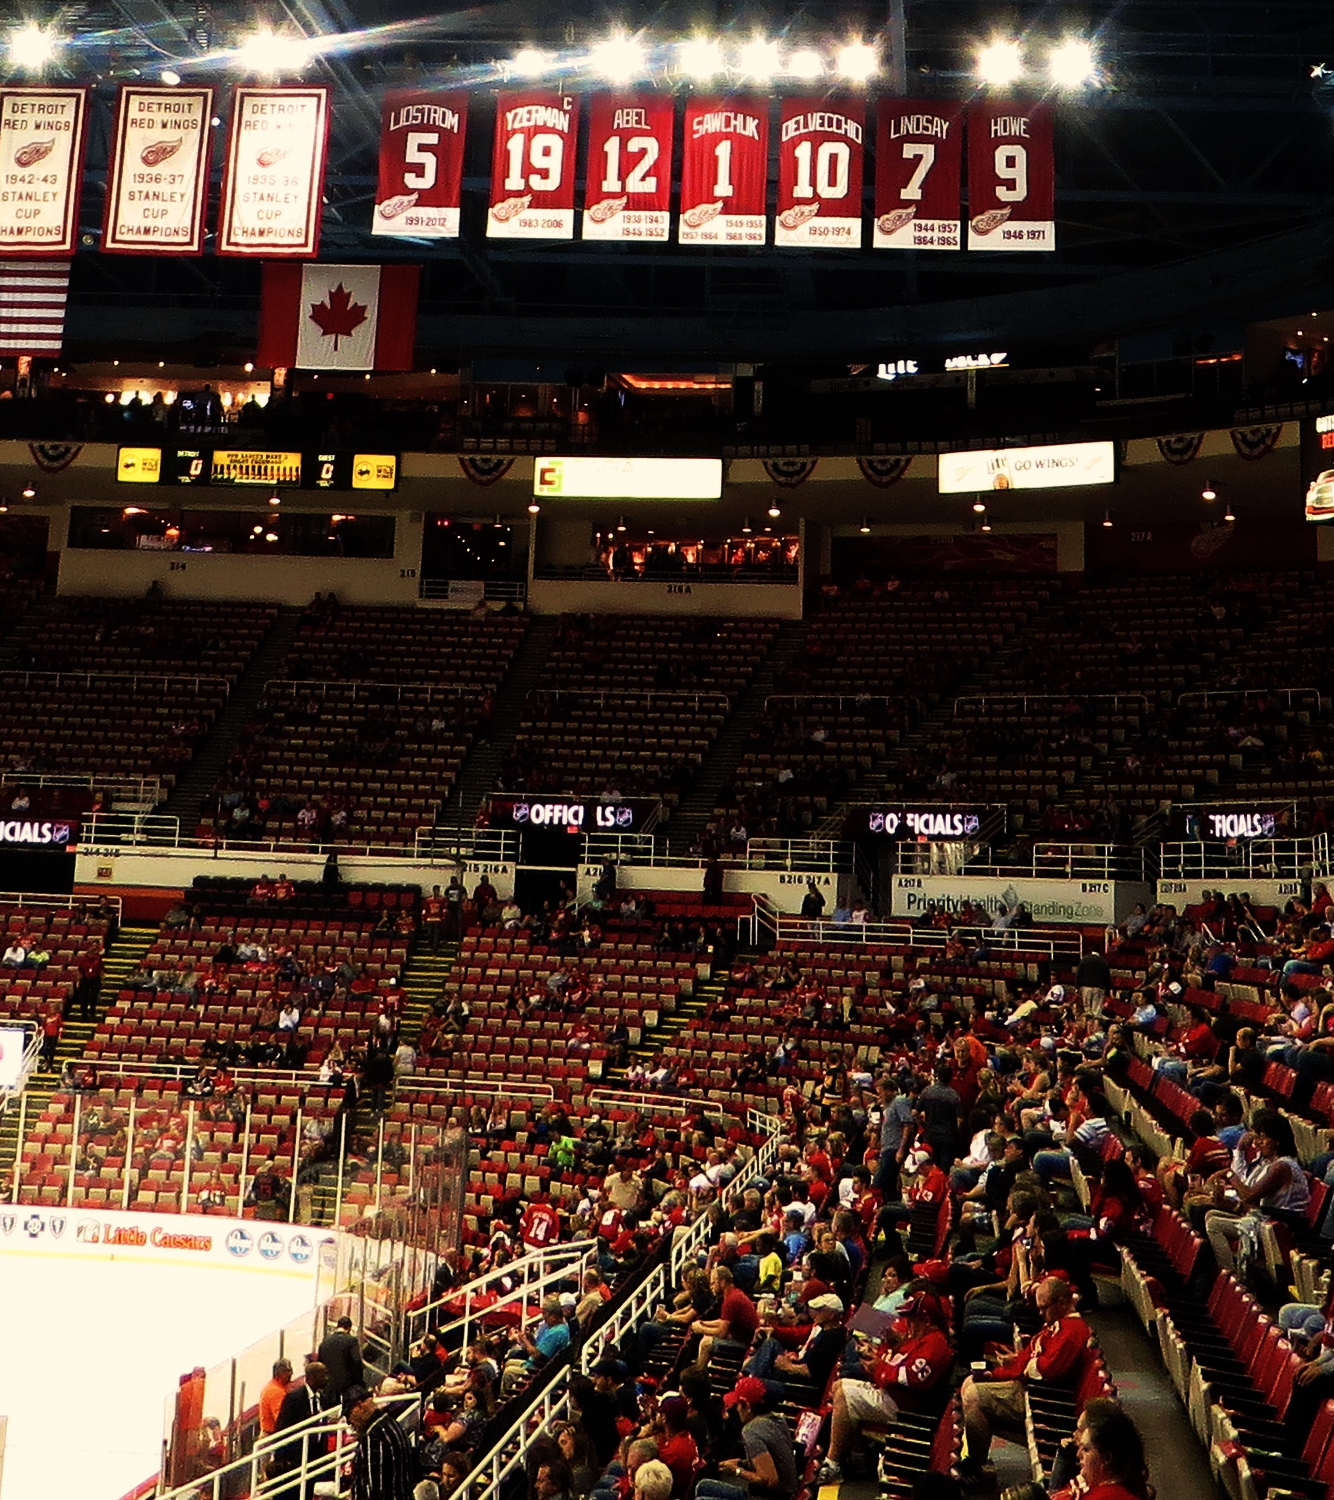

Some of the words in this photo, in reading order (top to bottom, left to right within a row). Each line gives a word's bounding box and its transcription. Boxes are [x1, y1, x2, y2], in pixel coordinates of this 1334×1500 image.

[12, 103, 66, 115] DETROIT
[564, 97, 573, 110] C
[3, 119, 29, 130] RED
[34, 121, 71, 132] WINGS
[389, 105, 459, 133] LIDSTROM
[506, 106, 569, 133] YZERMAN
[613, 108, 651, 129] ABEL
[693, 112, 759, 141] SAWCHUK
[782, 113, 862, 144] DELVECCHIO
[890, 115, 949, 139] LINDSAY
[991, 116, 1030, 139] HOWE
[404, 133, 439, 189] 5
[504, 133, 564, 191] 19
[602, 136, 659, 193] 12
[713, 140, 733, 197] 1
[792, 141, 850, 199] 10
[900, 143, 935, 199] 7
[994, 144, 1028, 201] 9
[5, 173, 57, 185] 1942-43
[1, 190, 58, 202] STANLEY
[15, 208, 41, 219] CUP
[1015, 460, 1032, 471] GO
[529, 1220, 546, 1238] 14
